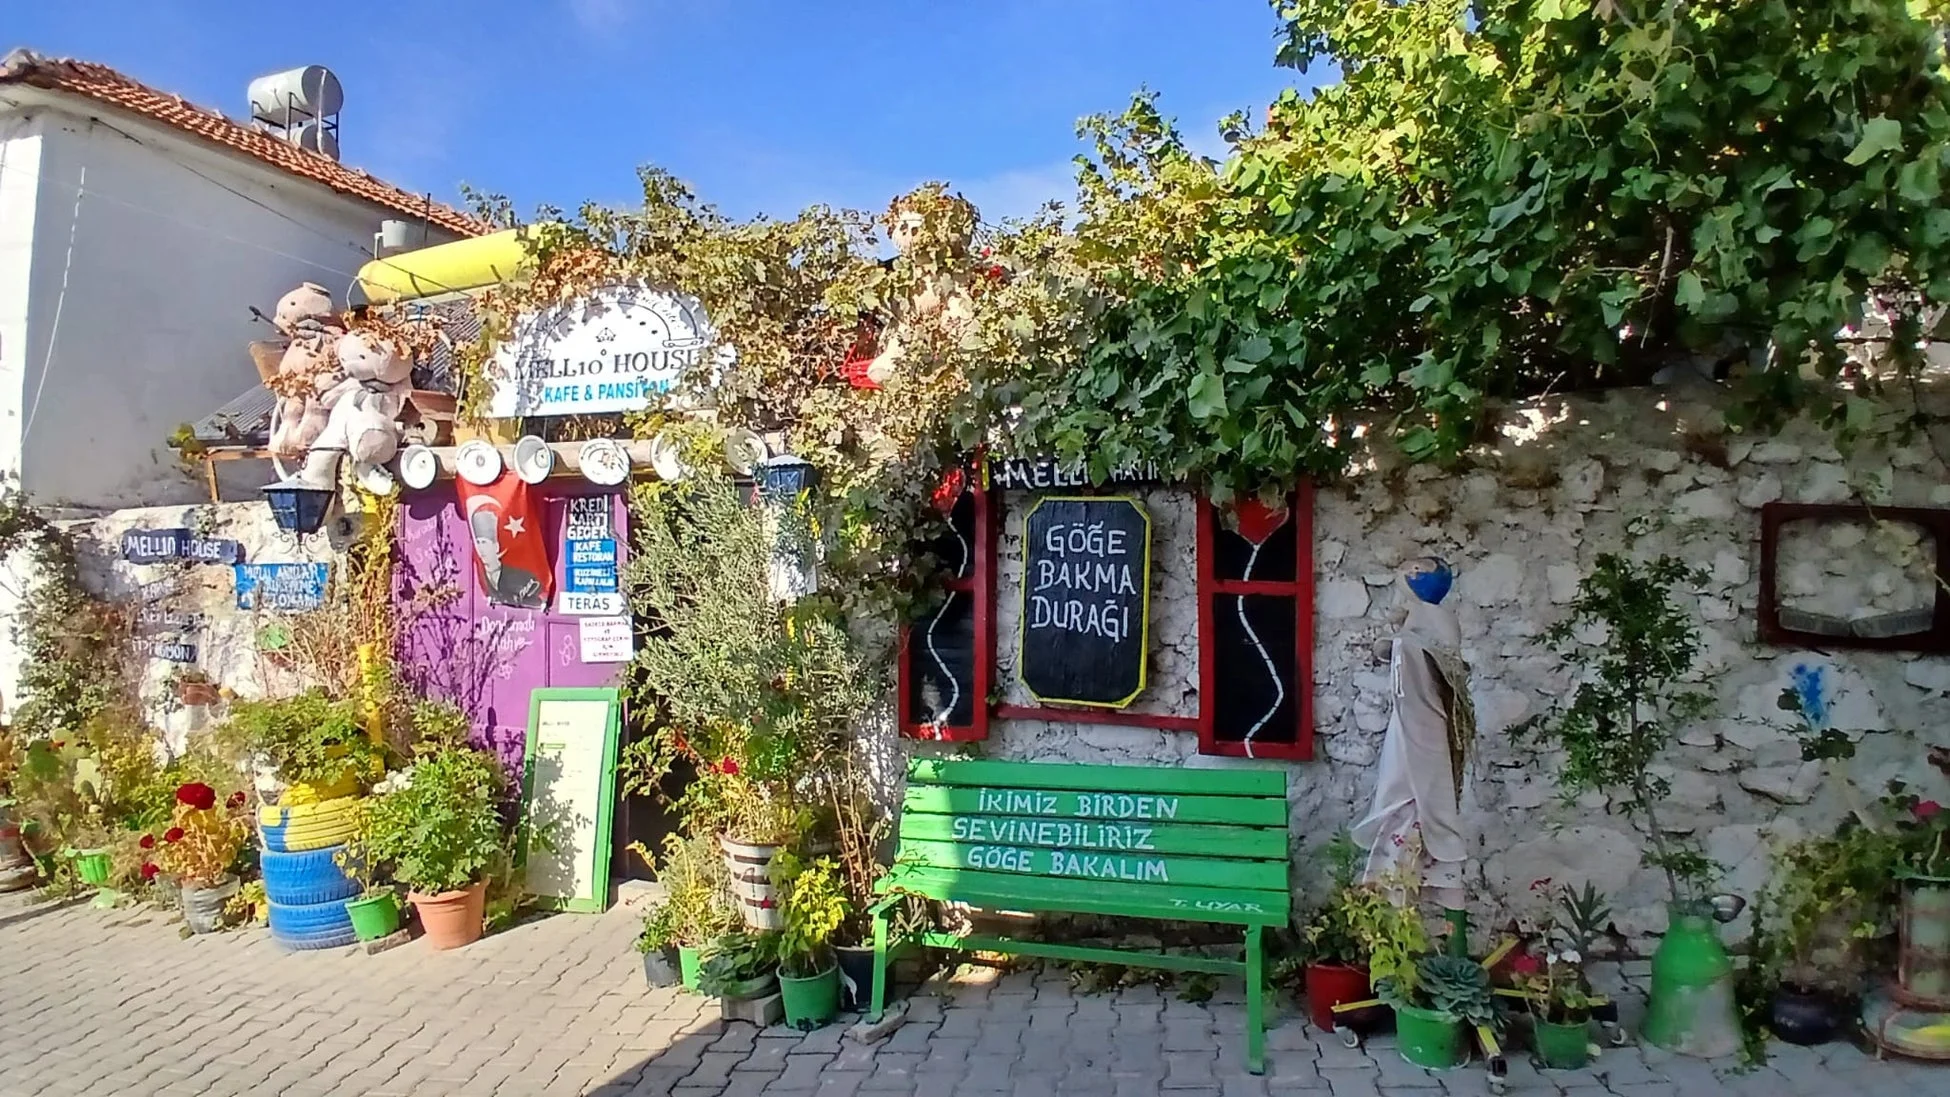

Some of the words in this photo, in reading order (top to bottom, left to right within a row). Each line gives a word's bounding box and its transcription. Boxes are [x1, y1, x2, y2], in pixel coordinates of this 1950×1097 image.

[544, 385, 579, 403] KAFE
[584, 384, 593, 401] &
[181, 539, 221, 559] HOUSE
[574, 540, 602, 552] KAFE
[1046, 521, 1126, 558] GÖĞE
[1034, 559, 1136, 595] BAKMA
[568, 597, 610, 610] TERAS
[1031, 595, 1128, 642] DURAĞI
[979, 788, 1057, 814] İKİMİZ
[1074, 794, 1178, 819] BİRDEN
[952, 817, 1155, 850] SEVİNEBİLİRİZ
[1049, 852, 1169, 882] BAKALIM
[1195, 900, 1263, 913] UYAR
